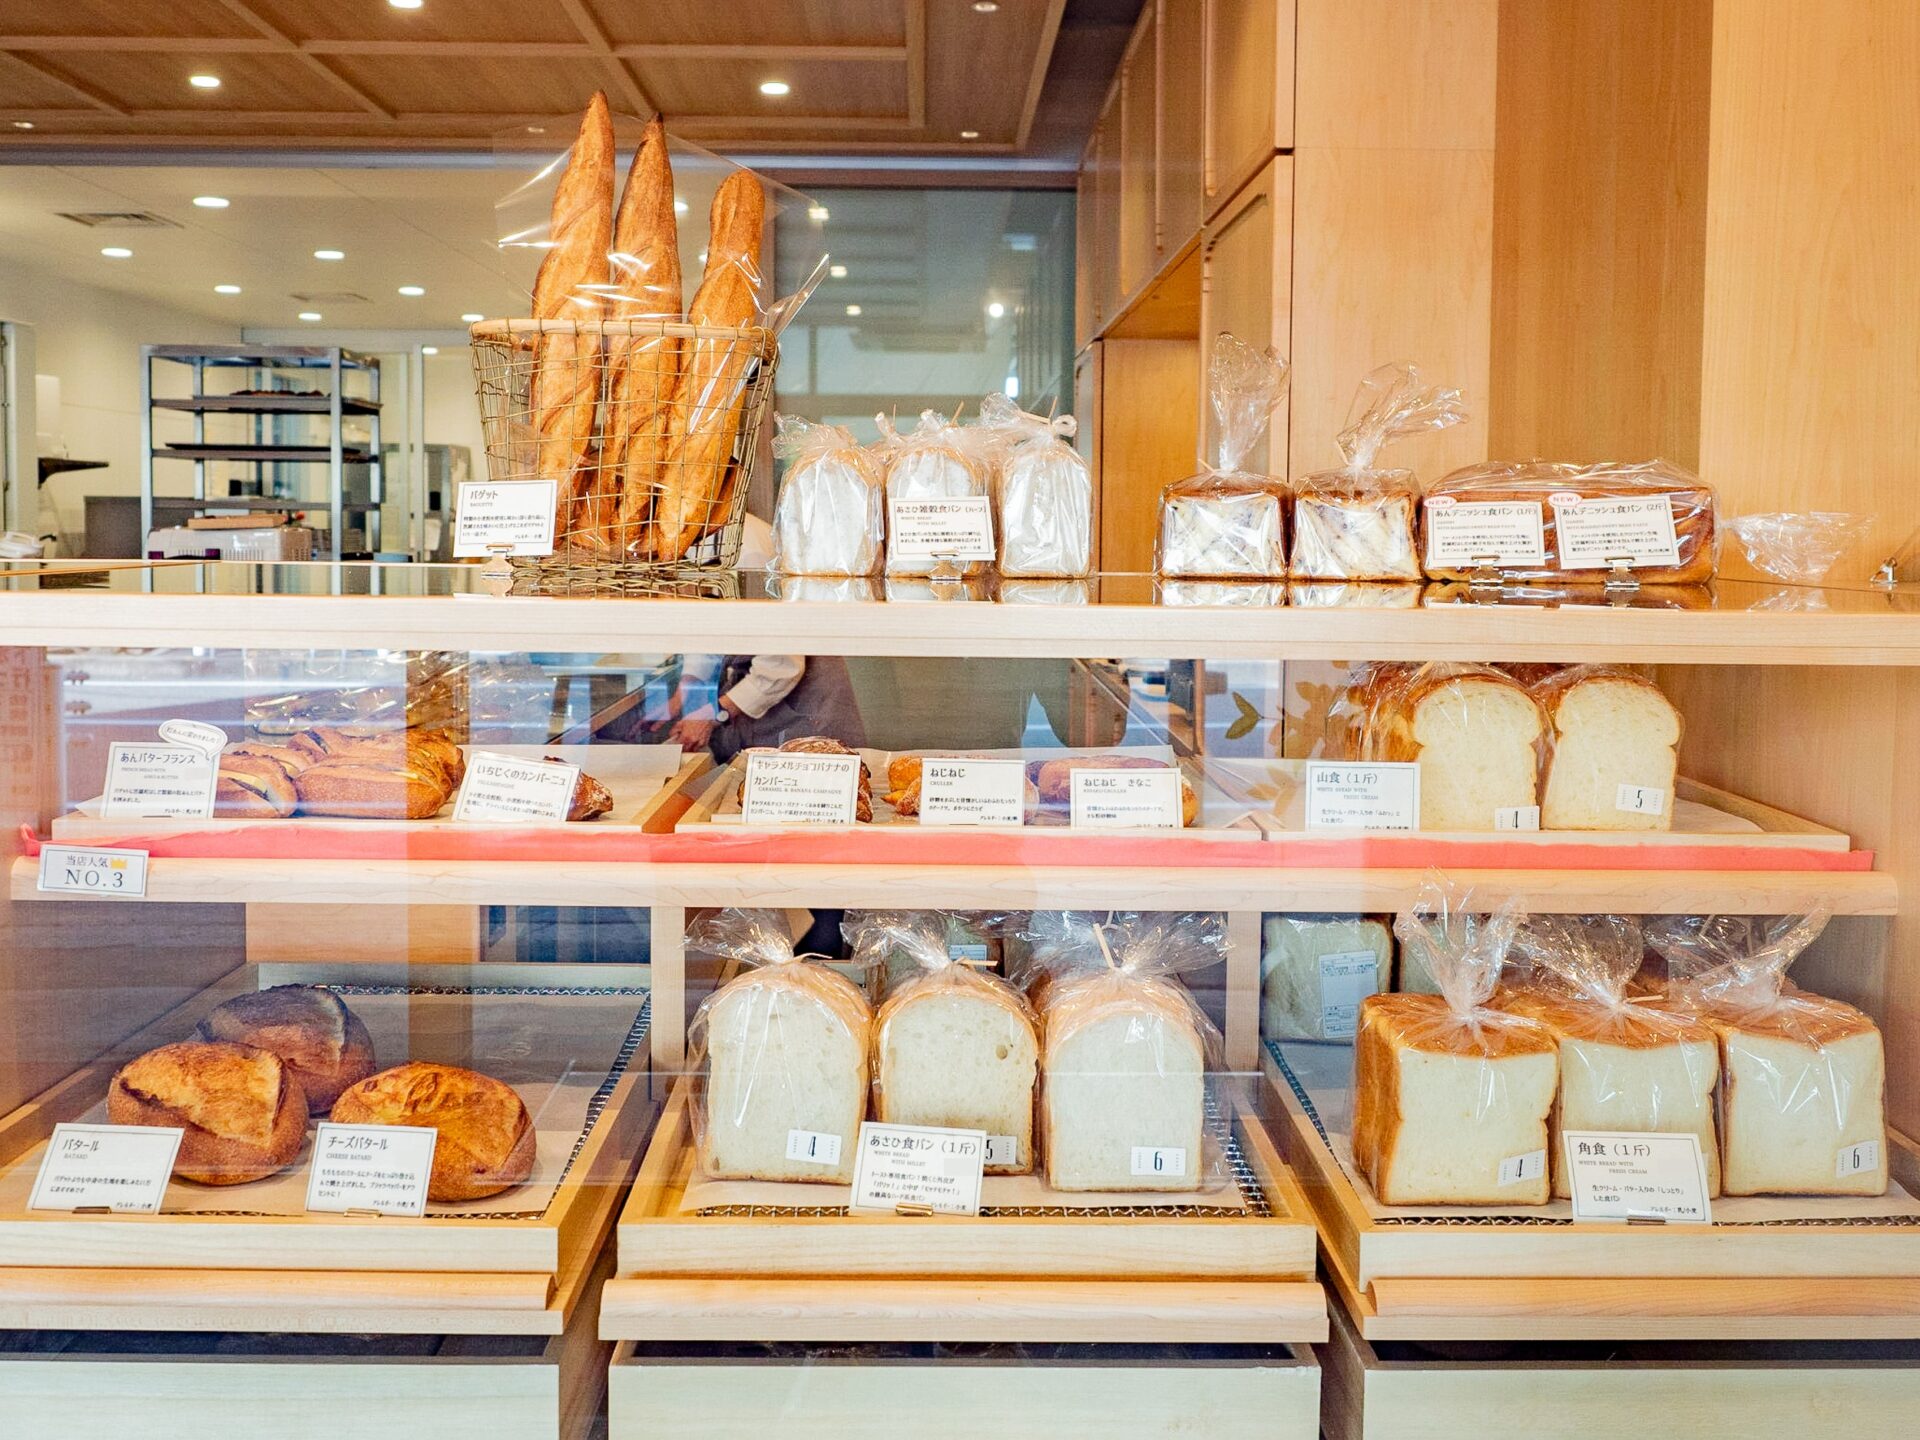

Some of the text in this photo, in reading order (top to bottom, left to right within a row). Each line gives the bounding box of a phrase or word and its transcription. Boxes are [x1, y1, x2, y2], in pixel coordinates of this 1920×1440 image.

[470, 489, 498, 500] バゲット
[120, 752, 196, 765] あんバターフランス
[757, 760, 850, 772] キャラメルチョコバナナの
[476, 765, 566, 786] いちじくのカンパーニュ
[930, 768, 966, 778] ねじねじ
[1316, 771, 1379, 784] 山食（1斤）
[754, 776, 798, 787] カンパーニュ
[1084, 778, 1152, 787] ねじねじ きなこ
[1635, 789, 1643, 809] 5
[1512, 810, 1519, 829] 4
[66, 855, 109, 868] 当店人気
[64, 869, 123, 888] NO.3
[62, 1139, 100, 1152] バタール
[328, 1136, 389, 1150] チーズバタール
[808, 1135, 816, 1157] 4
[870, 1135, 977, 1155] あさひ食パン（1斤）
[985, 1139, 993, 1160] 5
[1578, 1141, 1651, 1157] 角食（1斤）
[1154, 1151, 1163, 1171] 6
[1852, 1147, 1860, 1169] 6
